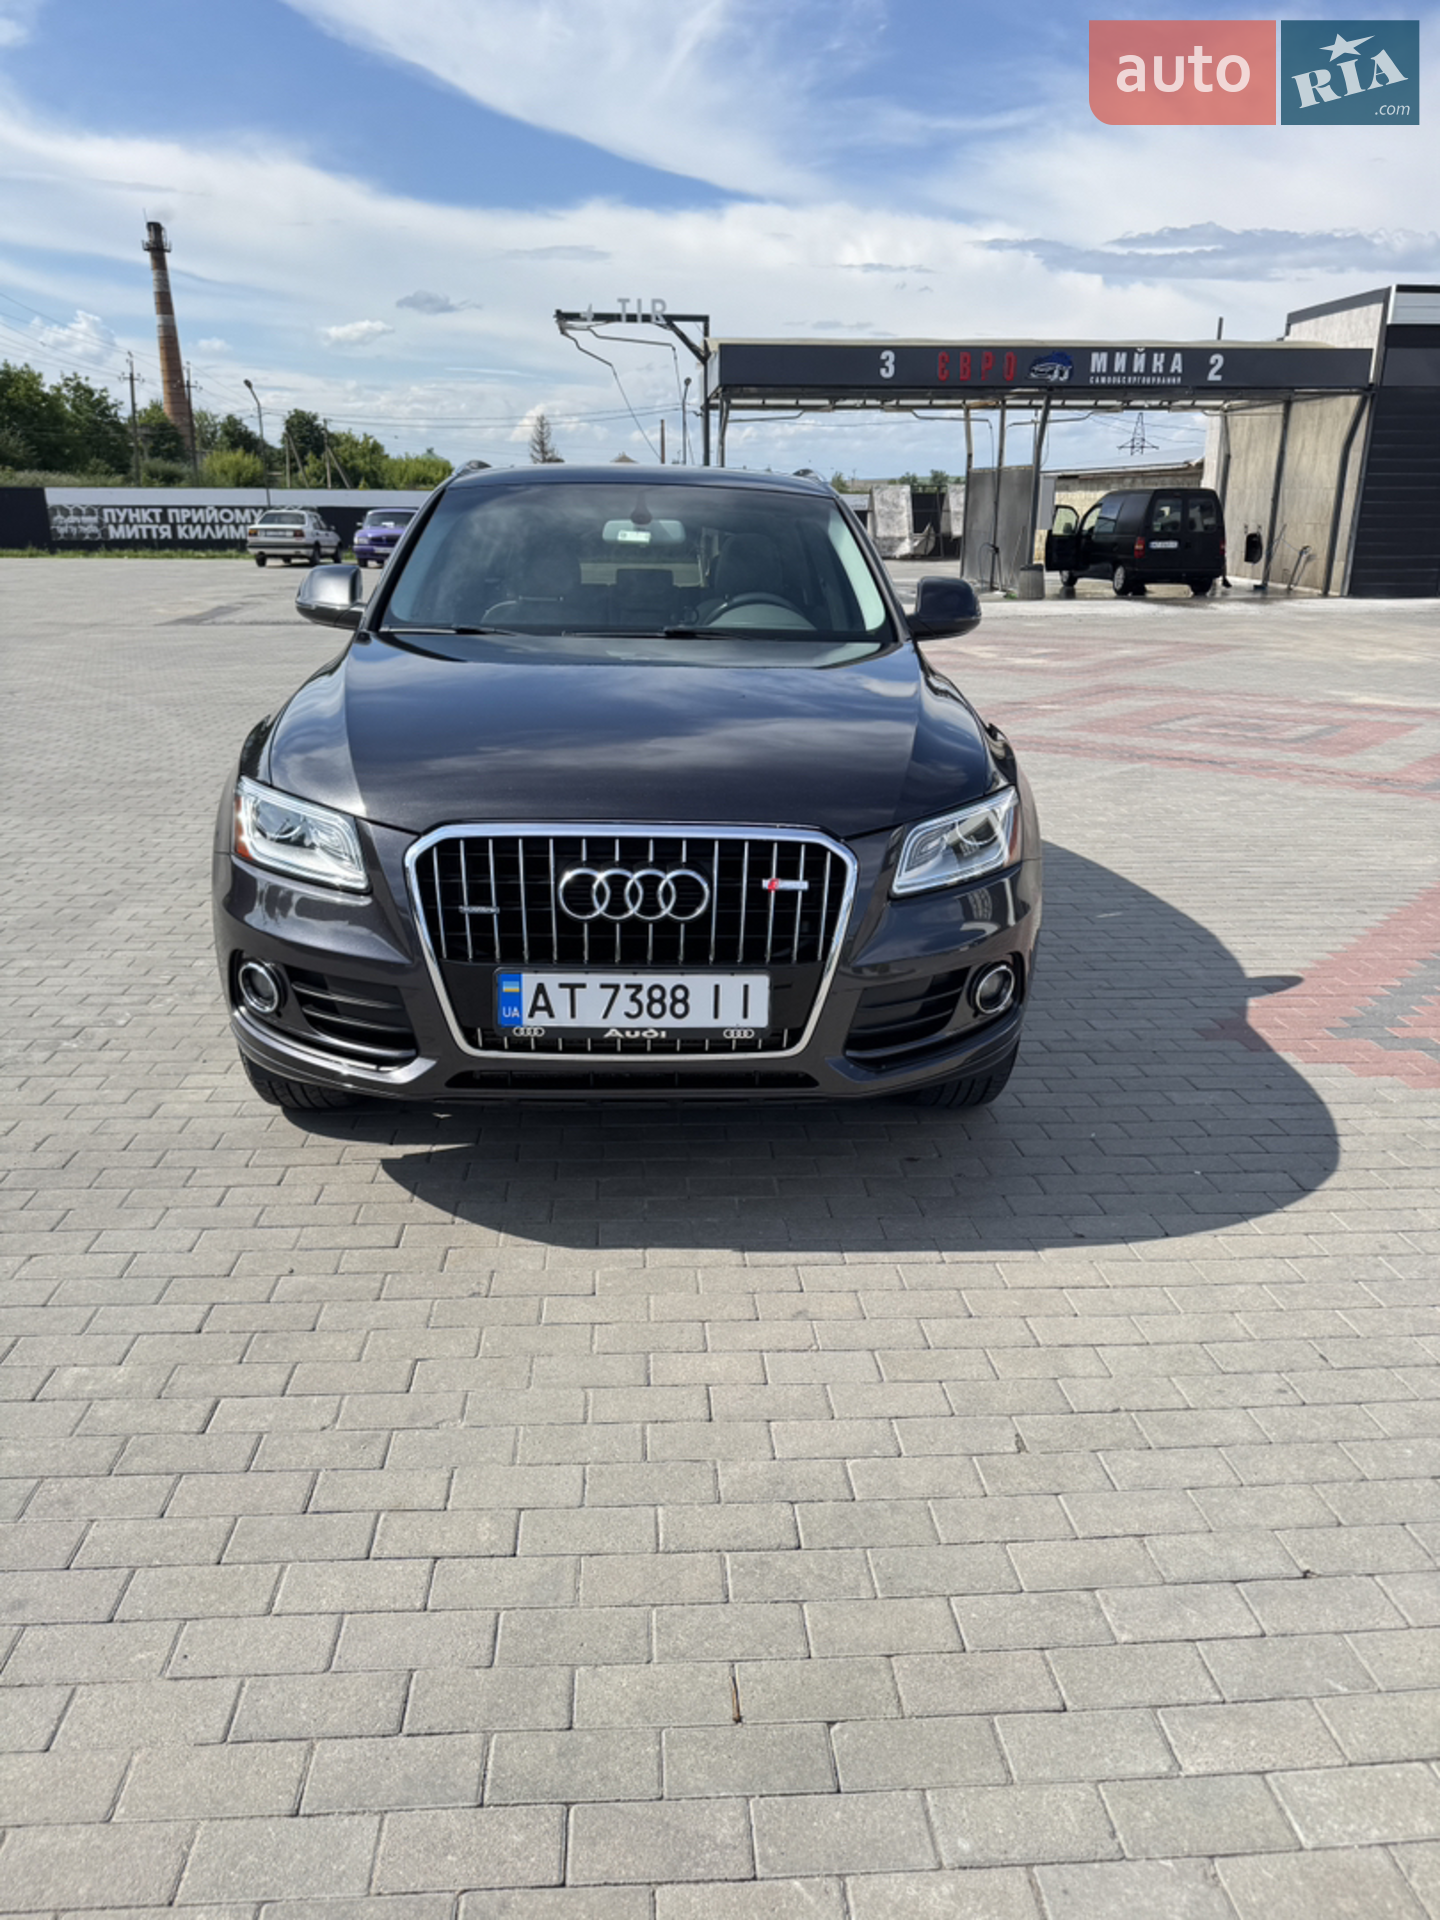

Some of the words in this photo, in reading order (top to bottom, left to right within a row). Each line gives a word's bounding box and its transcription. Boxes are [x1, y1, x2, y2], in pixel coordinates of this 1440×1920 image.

[617, 298, 667, 323] TIR
[880, 350, 895, 379] 3
[938, 351, 1018, 381] ЄВРО
[1090, 347, 1183, 373] МИЙКА
[1207, 353, 1224, 381] 2
[103, 508, 163, 523] ПУНКТ
[167, 506, 263, 524] ПРИЙОМУ
[108, 524, 172, 539] МИТТЯ
[503, 1006, 520, 1018] UA
[527, 982, 587, 1019] AT
[599, 983, 690, 1020] 7388
